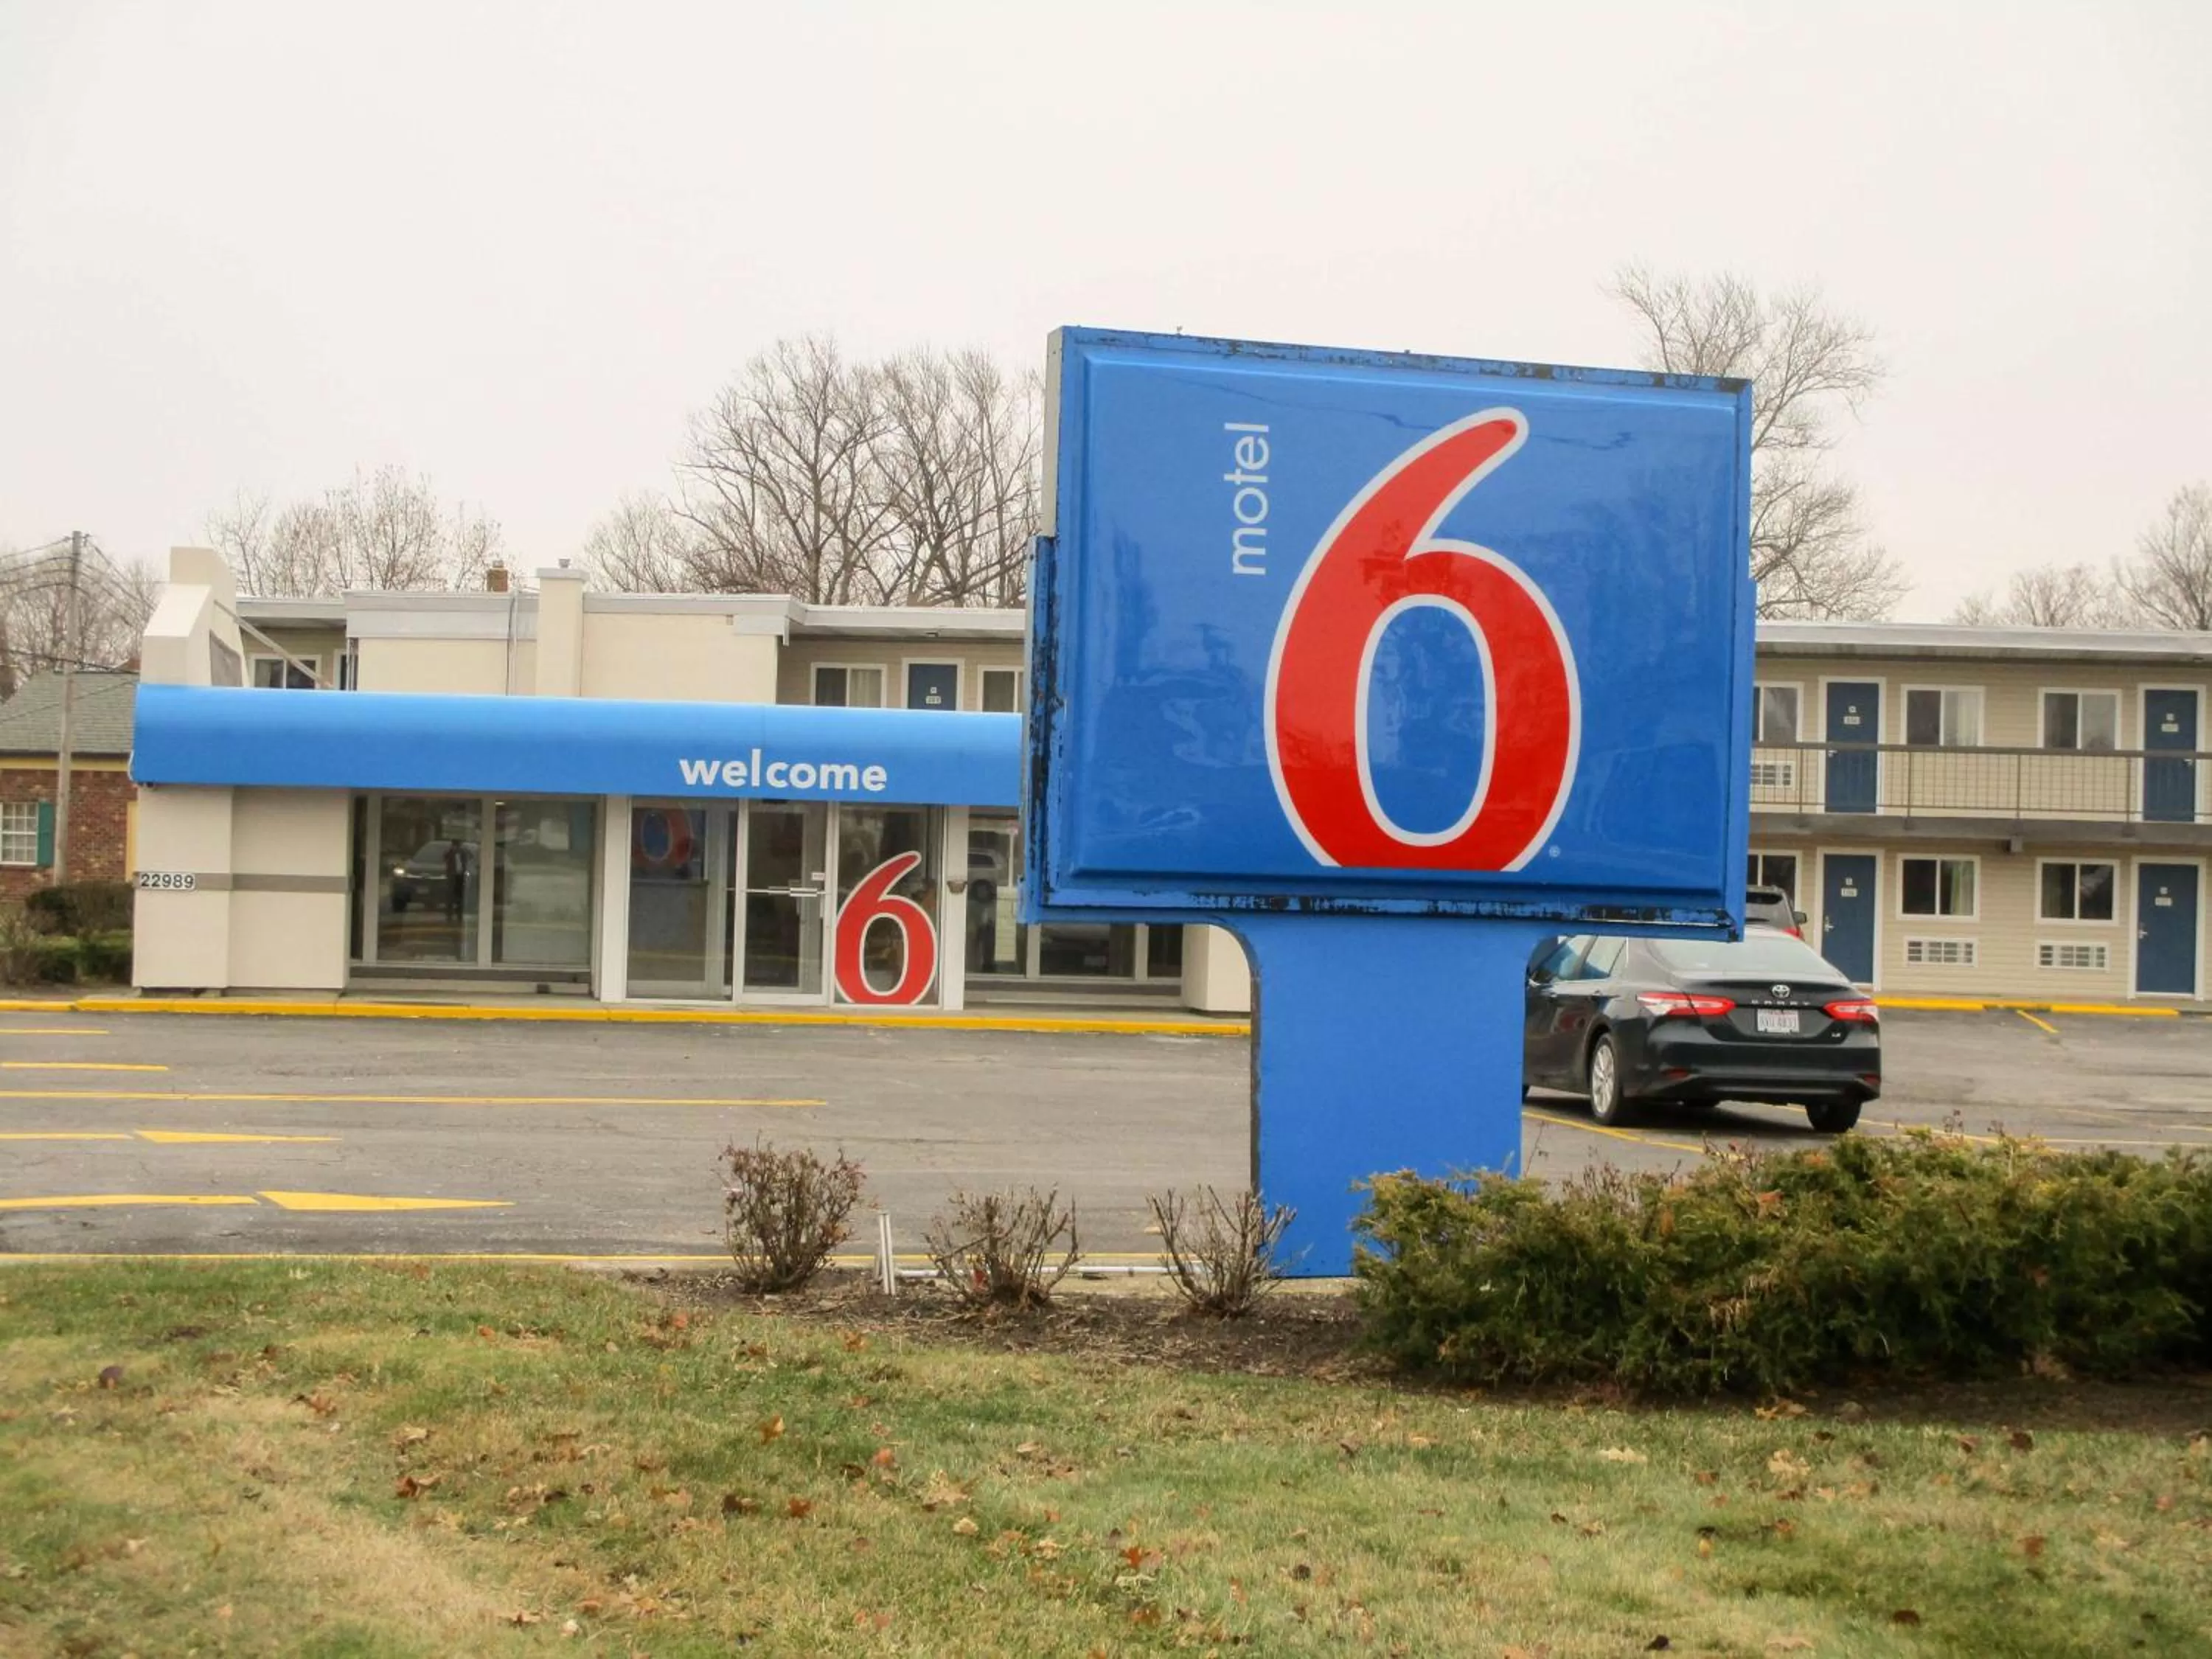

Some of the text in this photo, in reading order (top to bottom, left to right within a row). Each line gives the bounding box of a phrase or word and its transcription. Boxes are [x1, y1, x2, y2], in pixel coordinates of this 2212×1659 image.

[1224, 422, 1269, 575] motel
[1264, 406, 1582, 872] 6
[679, 748, 887, 791] welcome
[141, 873, 194, 888] 22989
[835, 851, 937, 1004] 6
